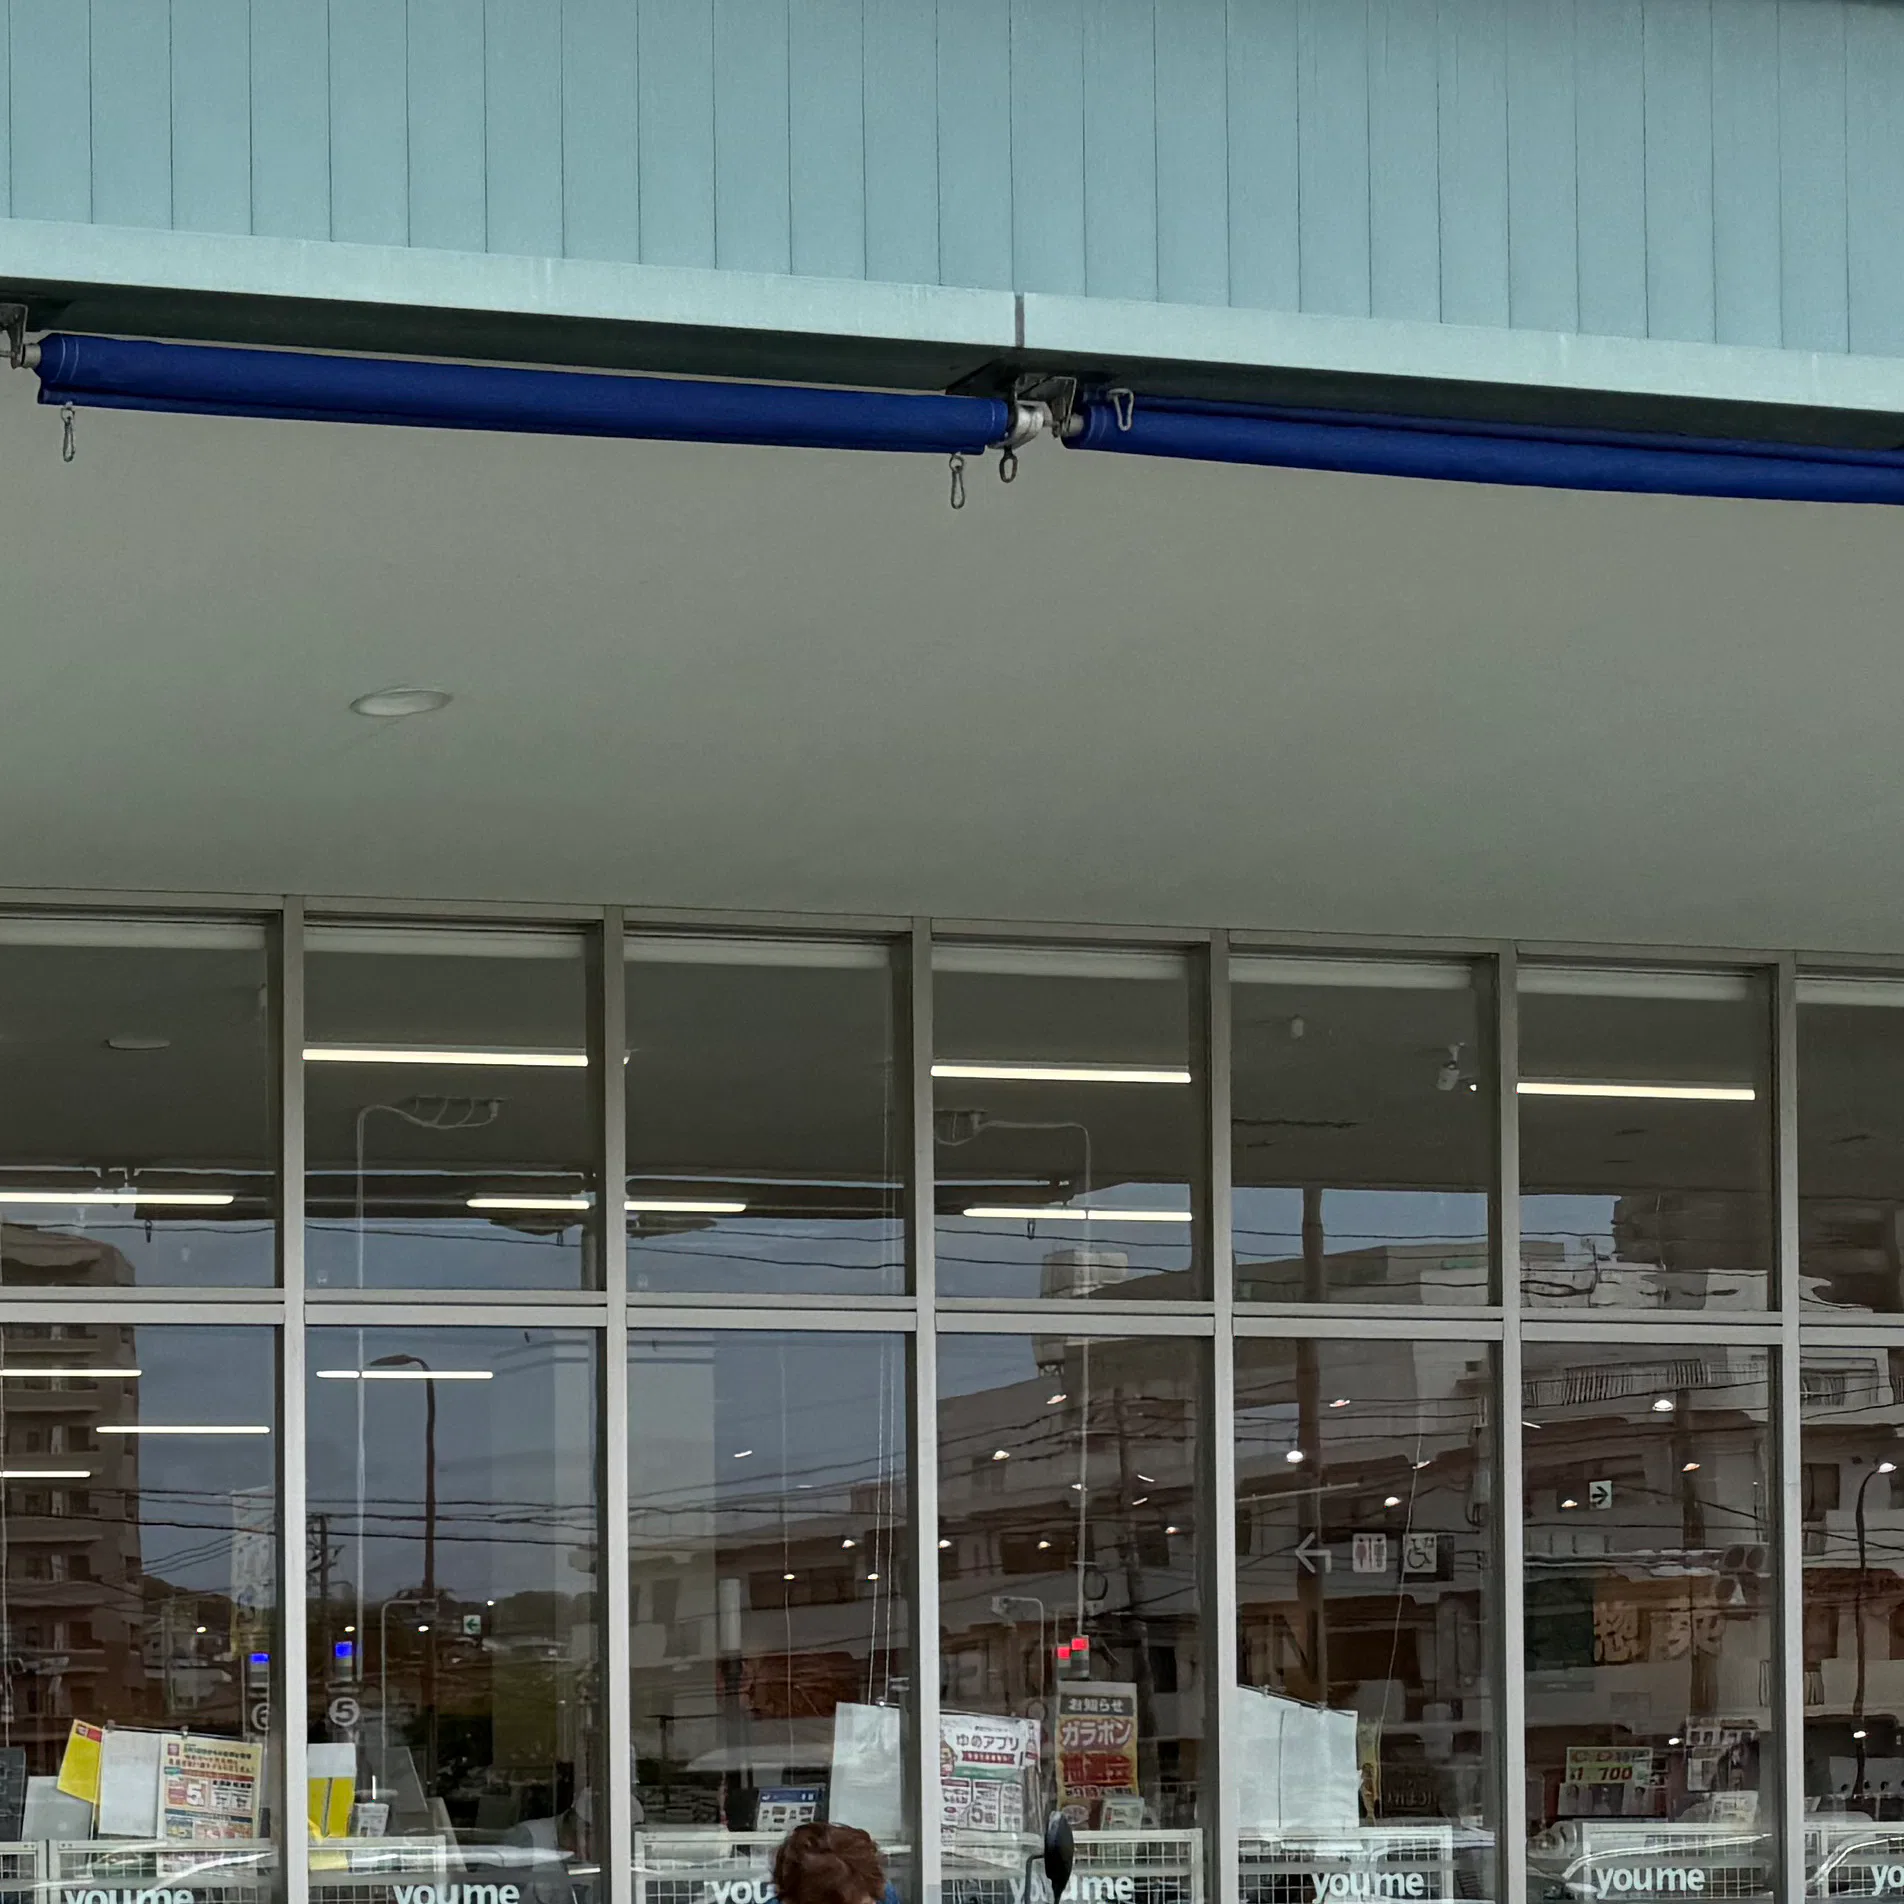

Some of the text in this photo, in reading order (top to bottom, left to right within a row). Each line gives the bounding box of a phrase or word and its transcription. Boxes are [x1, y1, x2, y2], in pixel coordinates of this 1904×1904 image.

[1061, 1719, 1132, 1747] ガラポン
[1311, 1872, 1425, 1904] youme
[1595, 1865, 1707, 1900] youme
